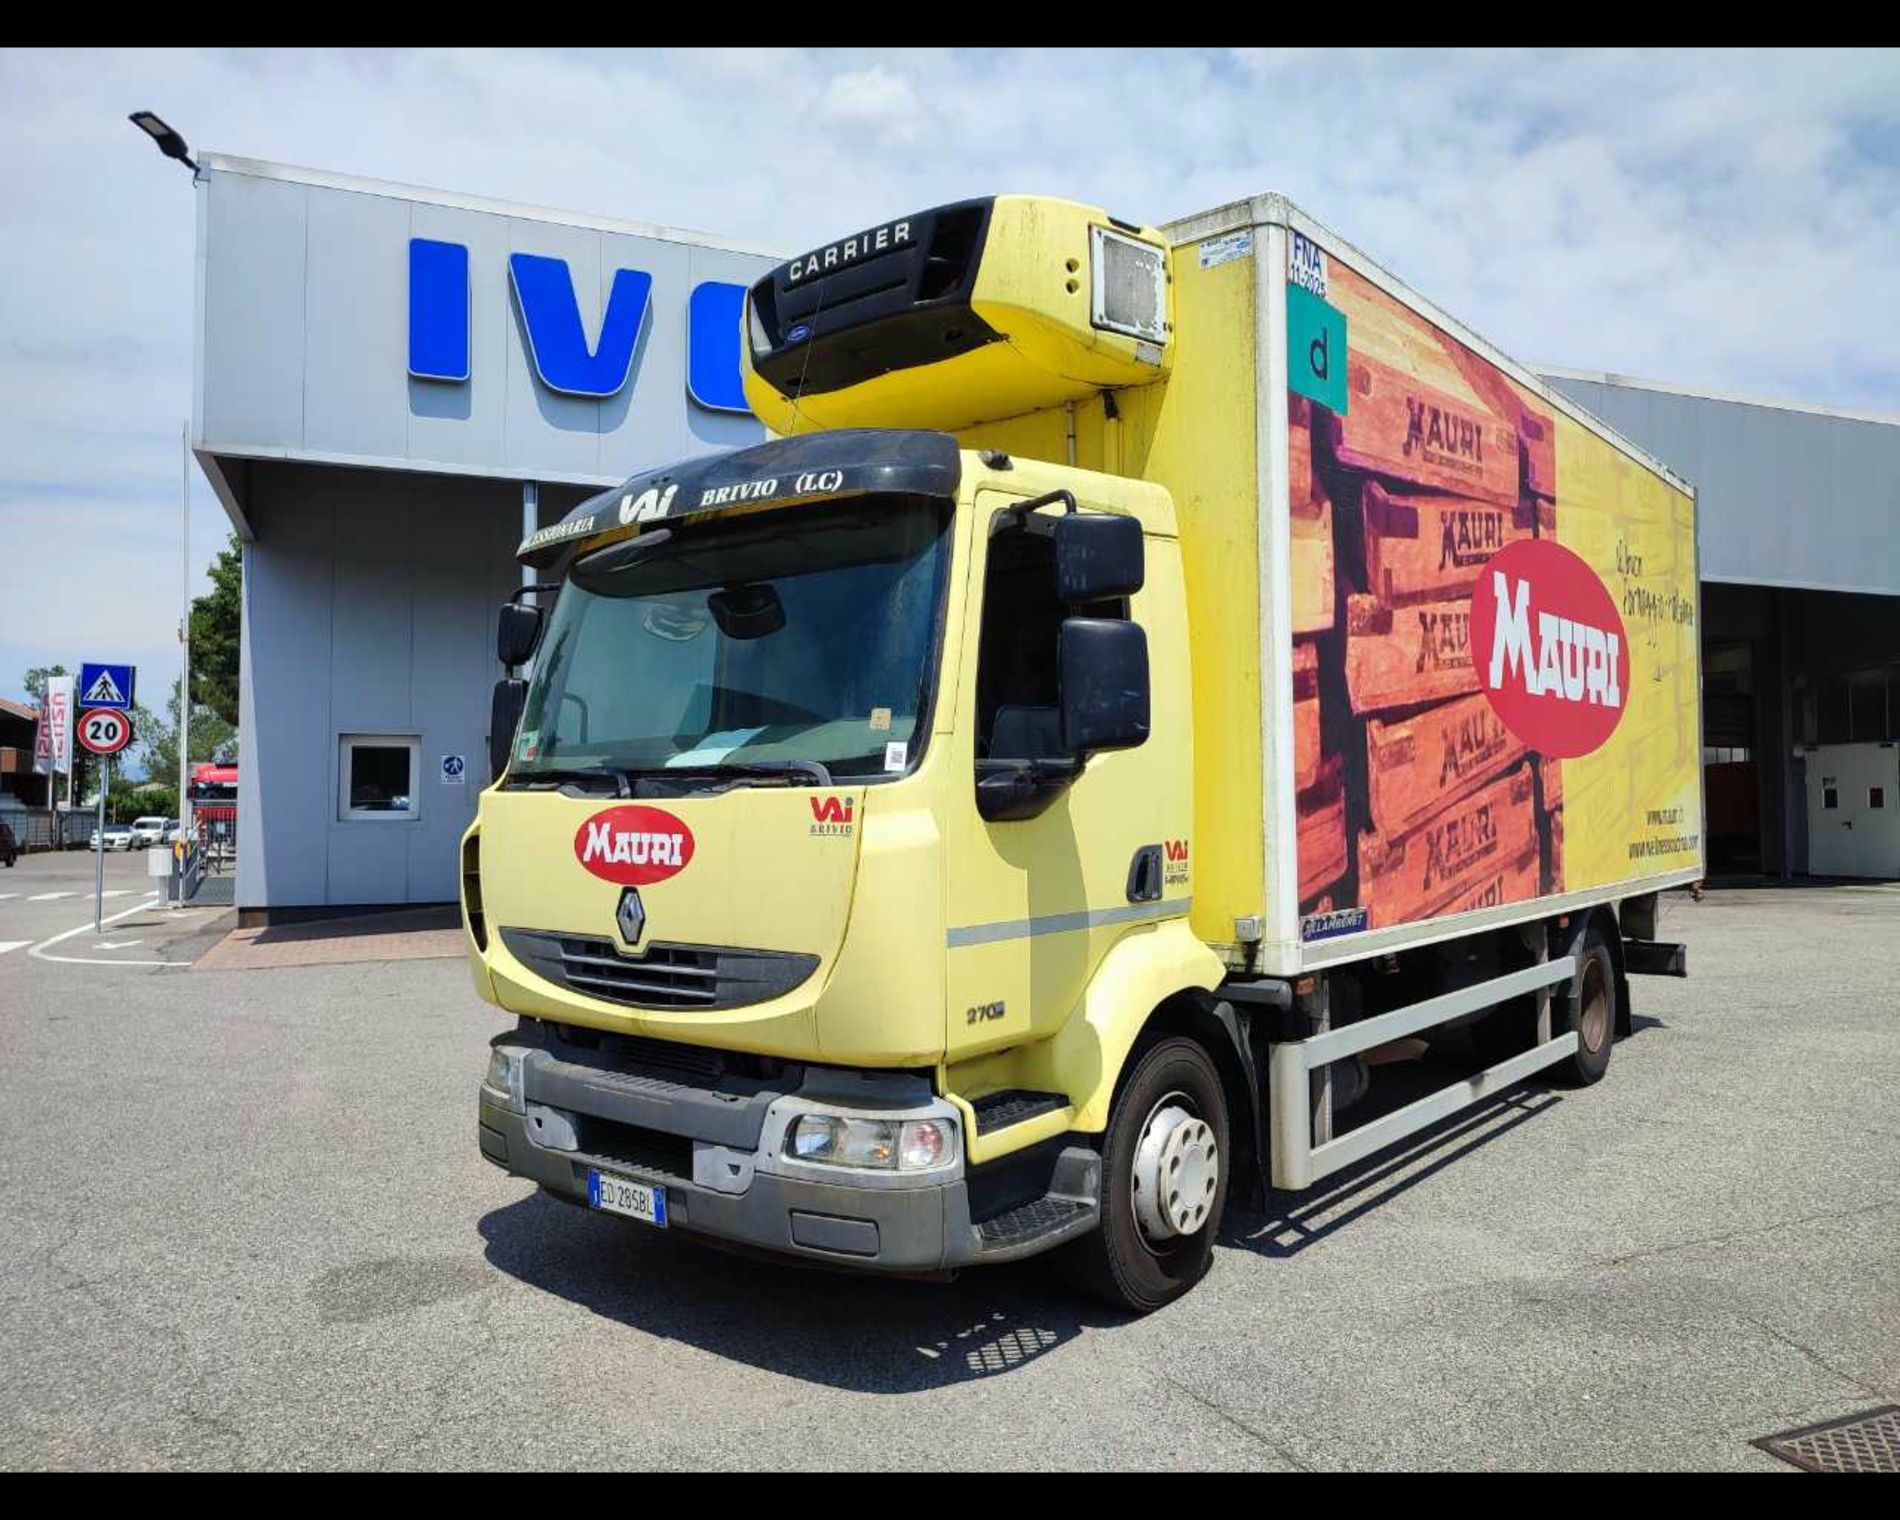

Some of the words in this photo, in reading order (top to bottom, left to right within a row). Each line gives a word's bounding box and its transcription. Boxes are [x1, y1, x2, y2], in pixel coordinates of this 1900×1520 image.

[789, 221, 911, 282] CARRIER
[1294, 232, 1322, 274] FNA
[1402, 396, 1483, 463] MAURI
[700, 479, 778, 507] BRIVIO
[795, 470, 843, 494] (LC)
[1438, 510, 1503, 571] MAURI
[1416, 611, 1472, 674] MAU
[1489, 570, 1620, 708] MAURI
[90, 720, 118, 741] 20
[583, 821, 683, 866] MAURI
[810, 824, 853, 834] BRIVIO
[967, 1003, 996, 1025] 270
[618, 1186, 654, 1215] 285BL
